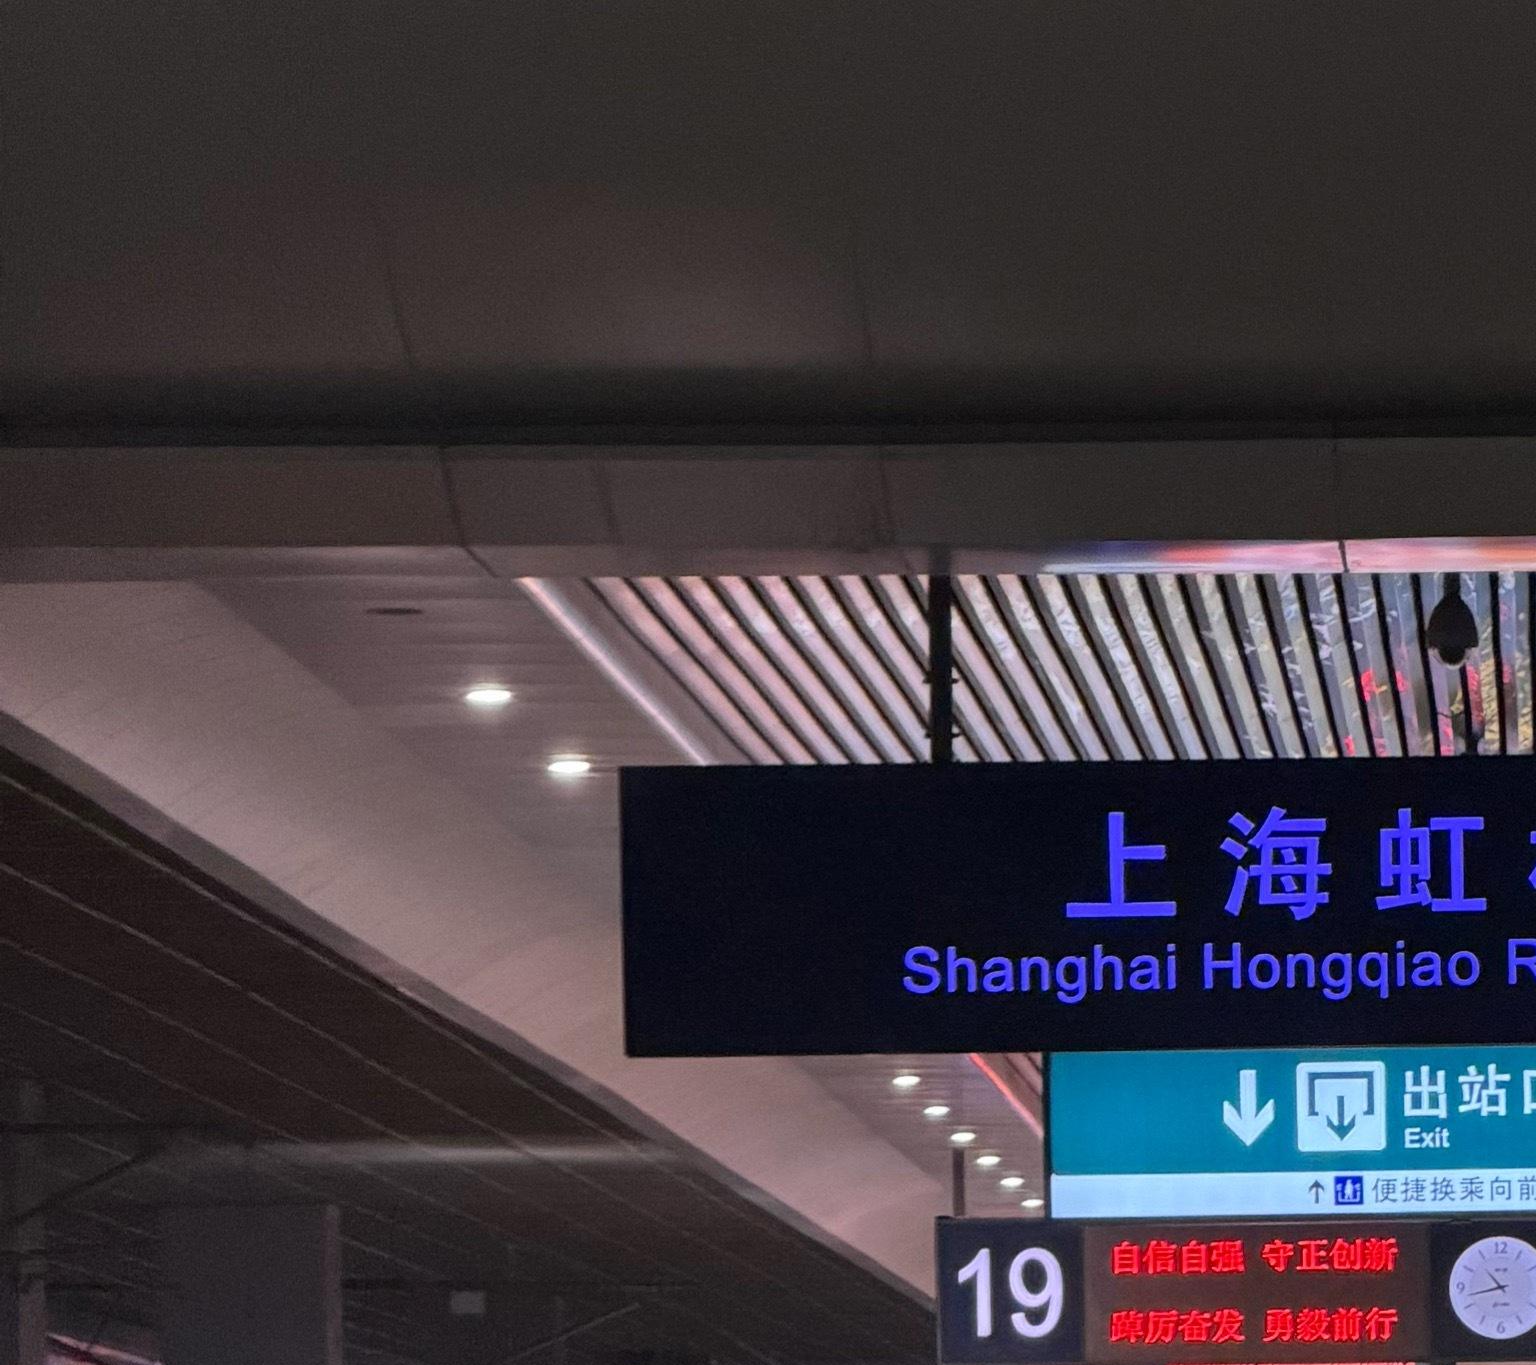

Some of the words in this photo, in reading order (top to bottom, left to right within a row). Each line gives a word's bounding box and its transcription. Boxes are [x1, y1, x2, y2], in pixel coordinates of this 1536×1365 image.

[902, 942, 1178, 1005] Shanghai
[1202, 939, 1481, 1002] Hongqiao
[1404, 1127, 1450, 1149] Exit
[1112, 1239, 1246, 1275] 自信自强
[1261, 1237, 1399, 1273] 守正创新
[957, 1246, 1064, 1338] 19
[1109, 1308, 1246, 1344] 踔厉奋发
[1261, 1306, 1399, 1342] 勇毅前行
